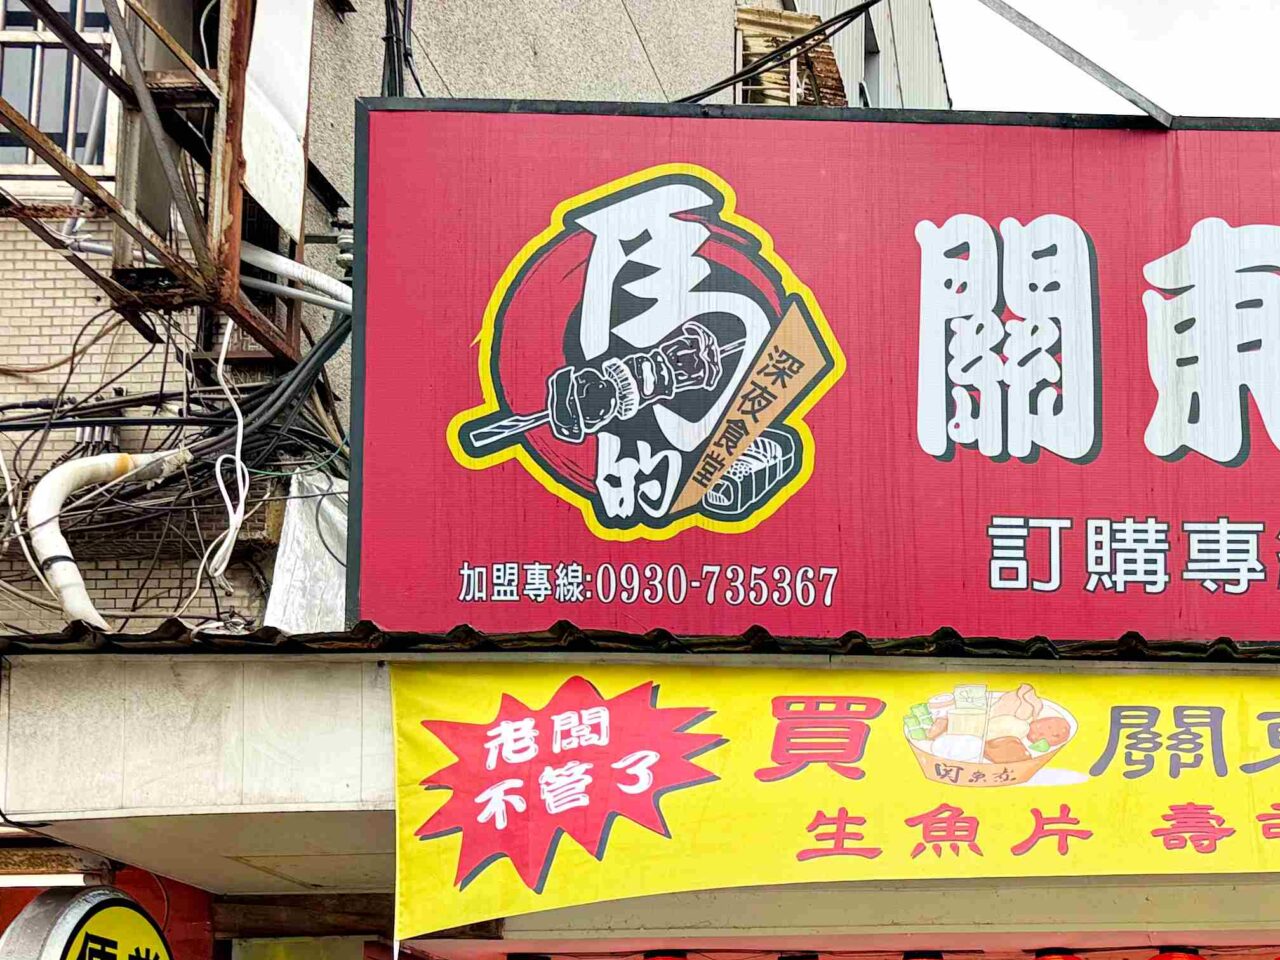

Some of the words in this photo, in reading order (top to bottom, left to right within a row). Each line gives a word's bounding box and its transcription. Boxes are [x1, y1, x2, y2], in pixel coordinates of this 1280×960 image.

[574, 184, 771, 518] 馬的
[692, 344, 806, 487] 深夜食堂
[458, 561, 840, 608] 加盟專線:0930-735367
[483, 704, 611, 773] 老闆
[752, 695, 886, 781] 買
[473, 749, 662, 832] 不管了
[796, 802, 1093, 862] 生魚片
